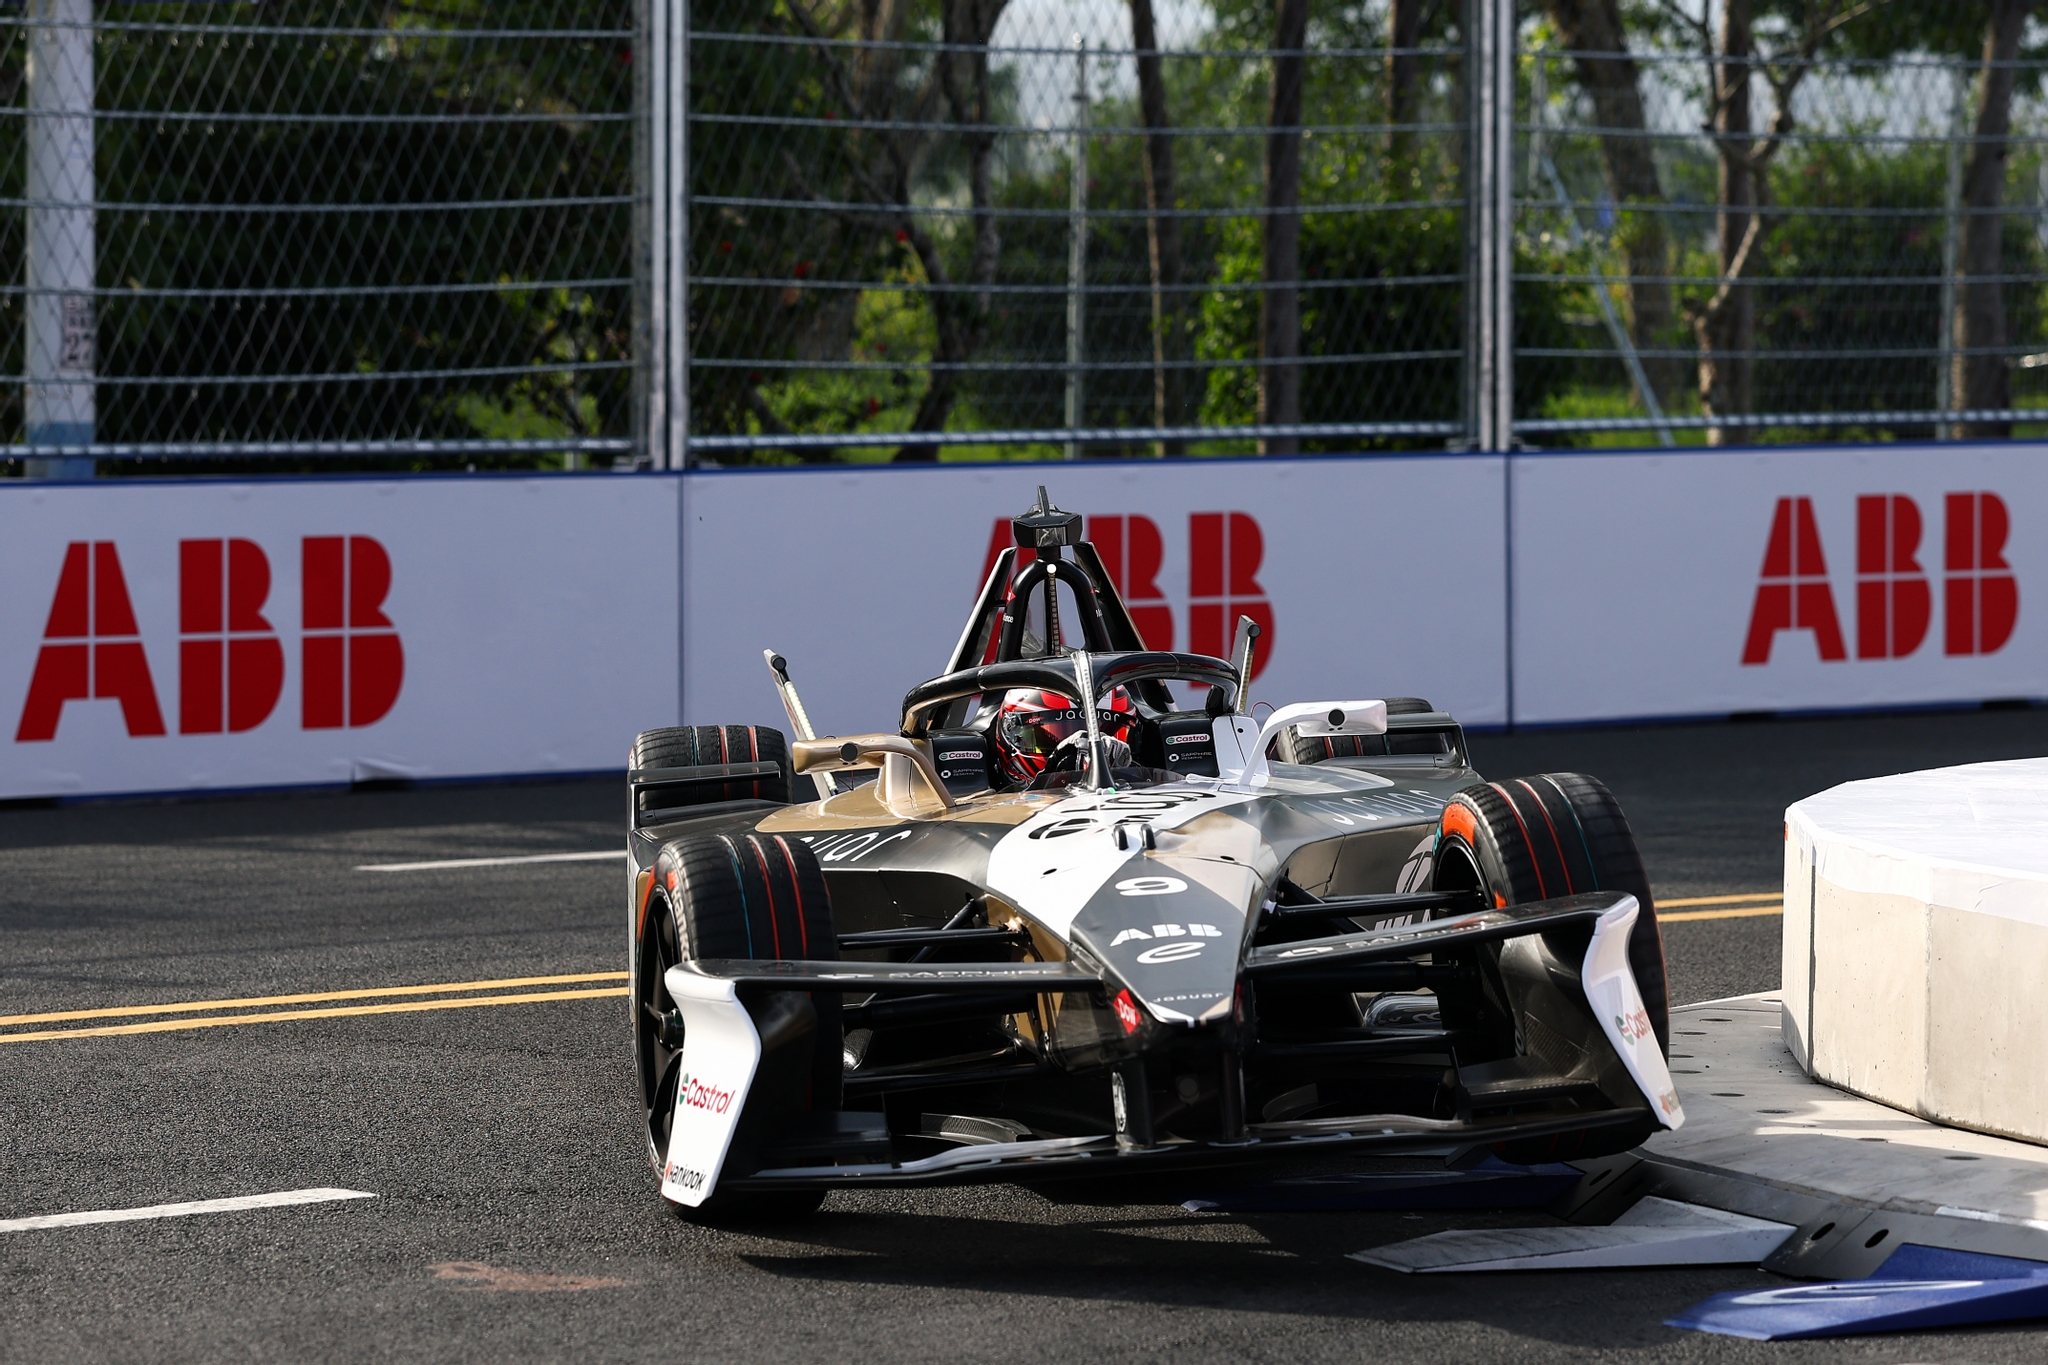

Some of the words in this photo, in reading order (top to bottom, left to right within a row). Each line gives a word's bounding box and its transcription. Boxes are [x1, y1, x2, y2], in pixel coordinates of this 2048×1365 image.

[1740, 489, 2021, 667] ABB
[14, 534, 406, 744] ABB
[1175, 734, 1208, 743] Castrol
[1114, 876, 1189, 896] 9
[1109, 923, 1223, 947] ABB
[686, 1078, 736, 1114] Castrol
